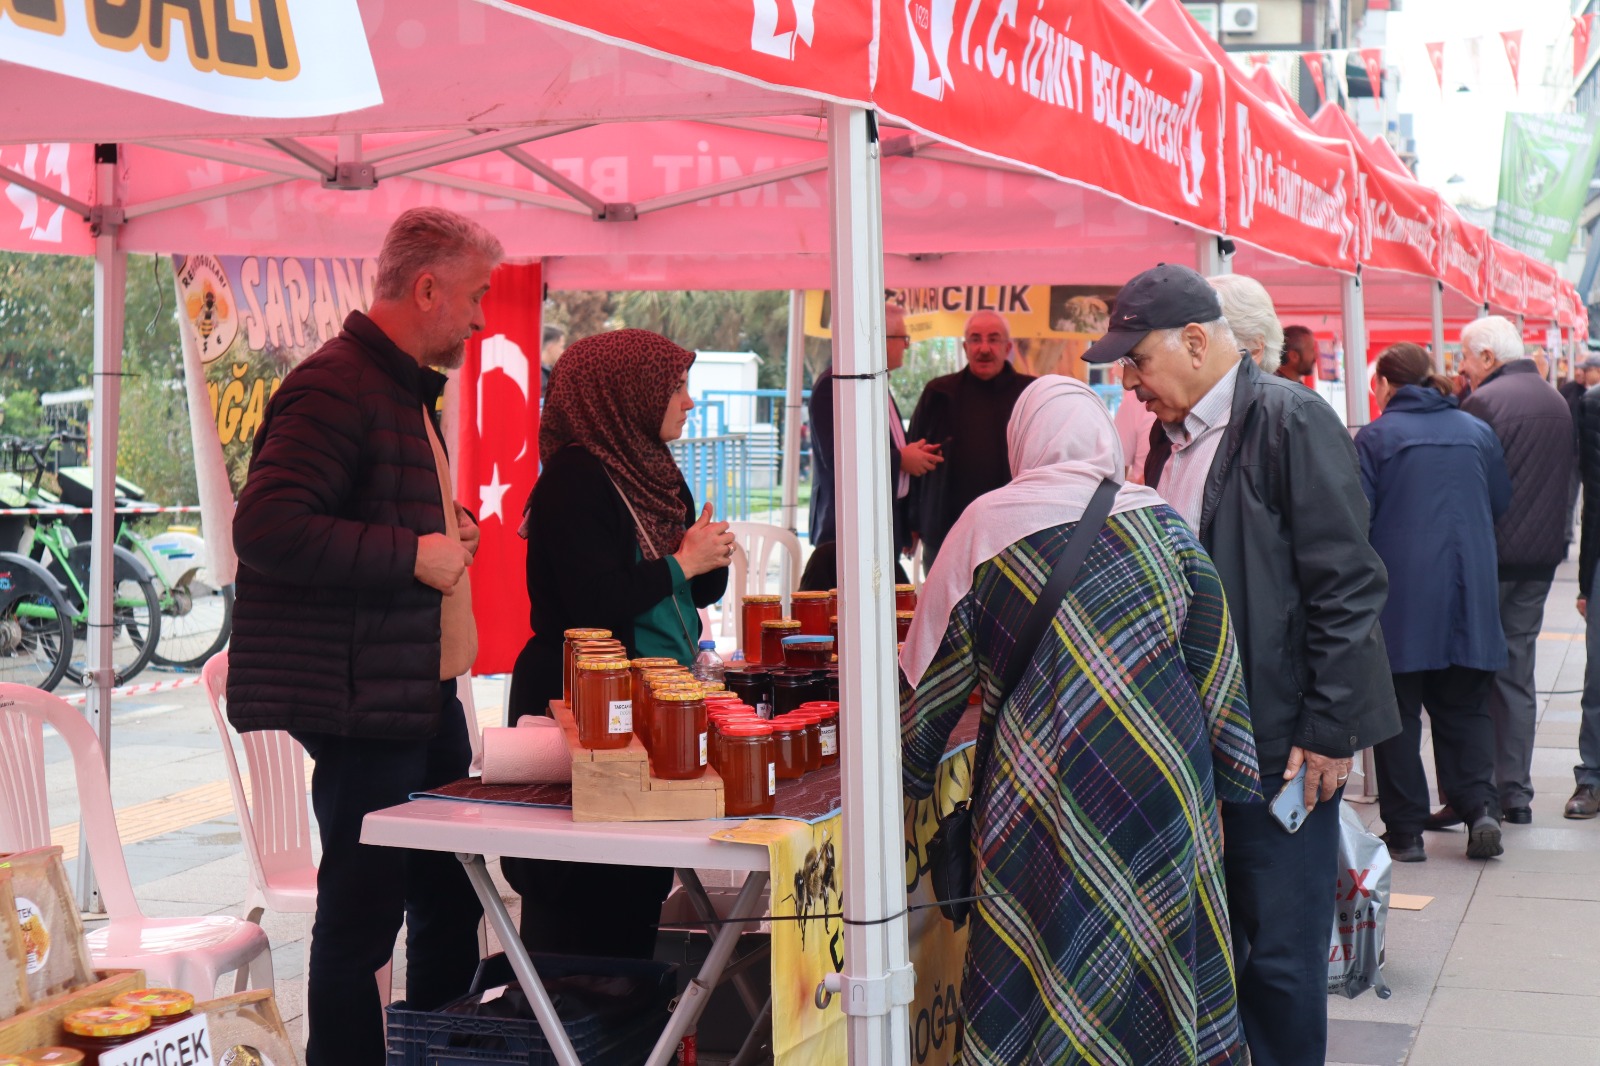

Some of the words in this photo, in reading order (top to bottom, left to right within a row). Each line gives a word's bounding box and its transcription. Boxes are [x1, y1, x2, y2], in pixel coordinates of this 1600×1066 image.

[914, 3, 929, 29] 1923
[1021, 0, 1086, 114] İZMİT
[909, 979, 964, 1066] OĞA
